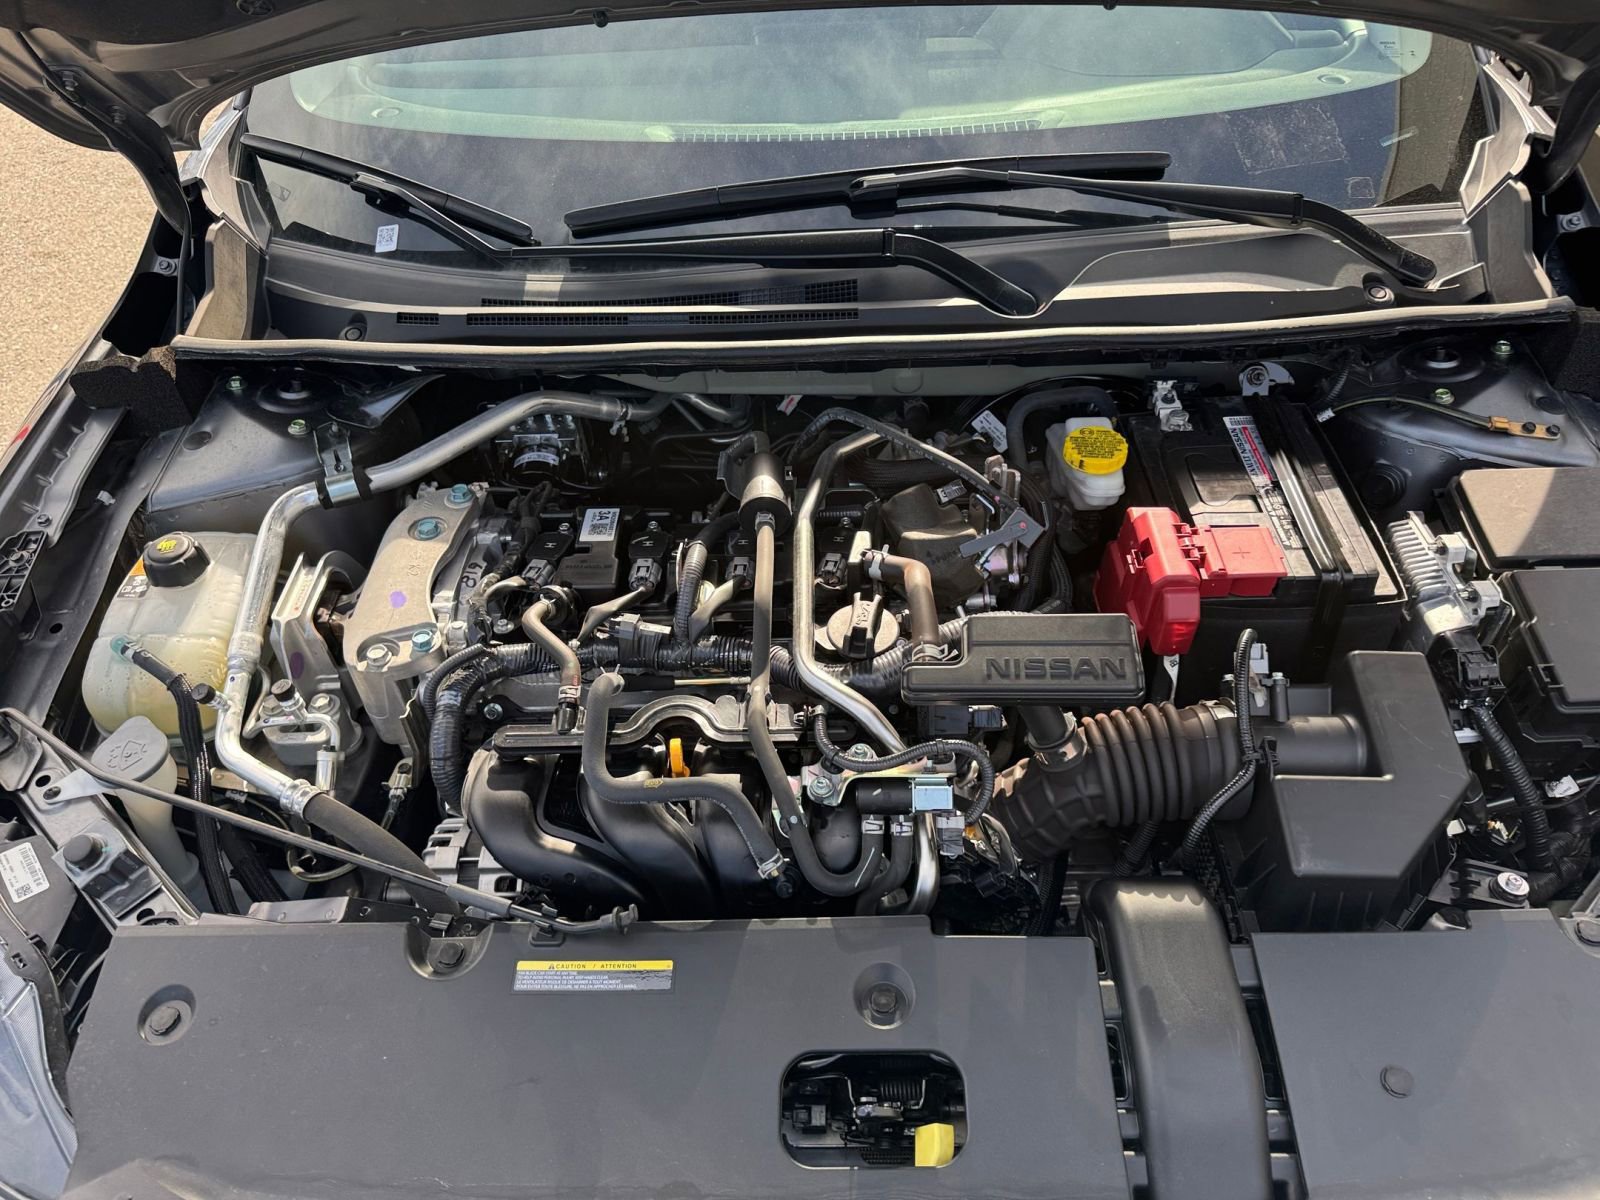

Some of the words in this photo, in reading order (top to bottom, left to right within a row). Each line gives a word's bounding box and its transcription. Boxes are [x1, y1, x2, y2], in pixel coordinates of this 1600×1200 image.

[1229, 427, 1247, 454] NISSAN
[597, 510, 610, 522] 3A
[986, 657, 1126, 681] NISSAN
